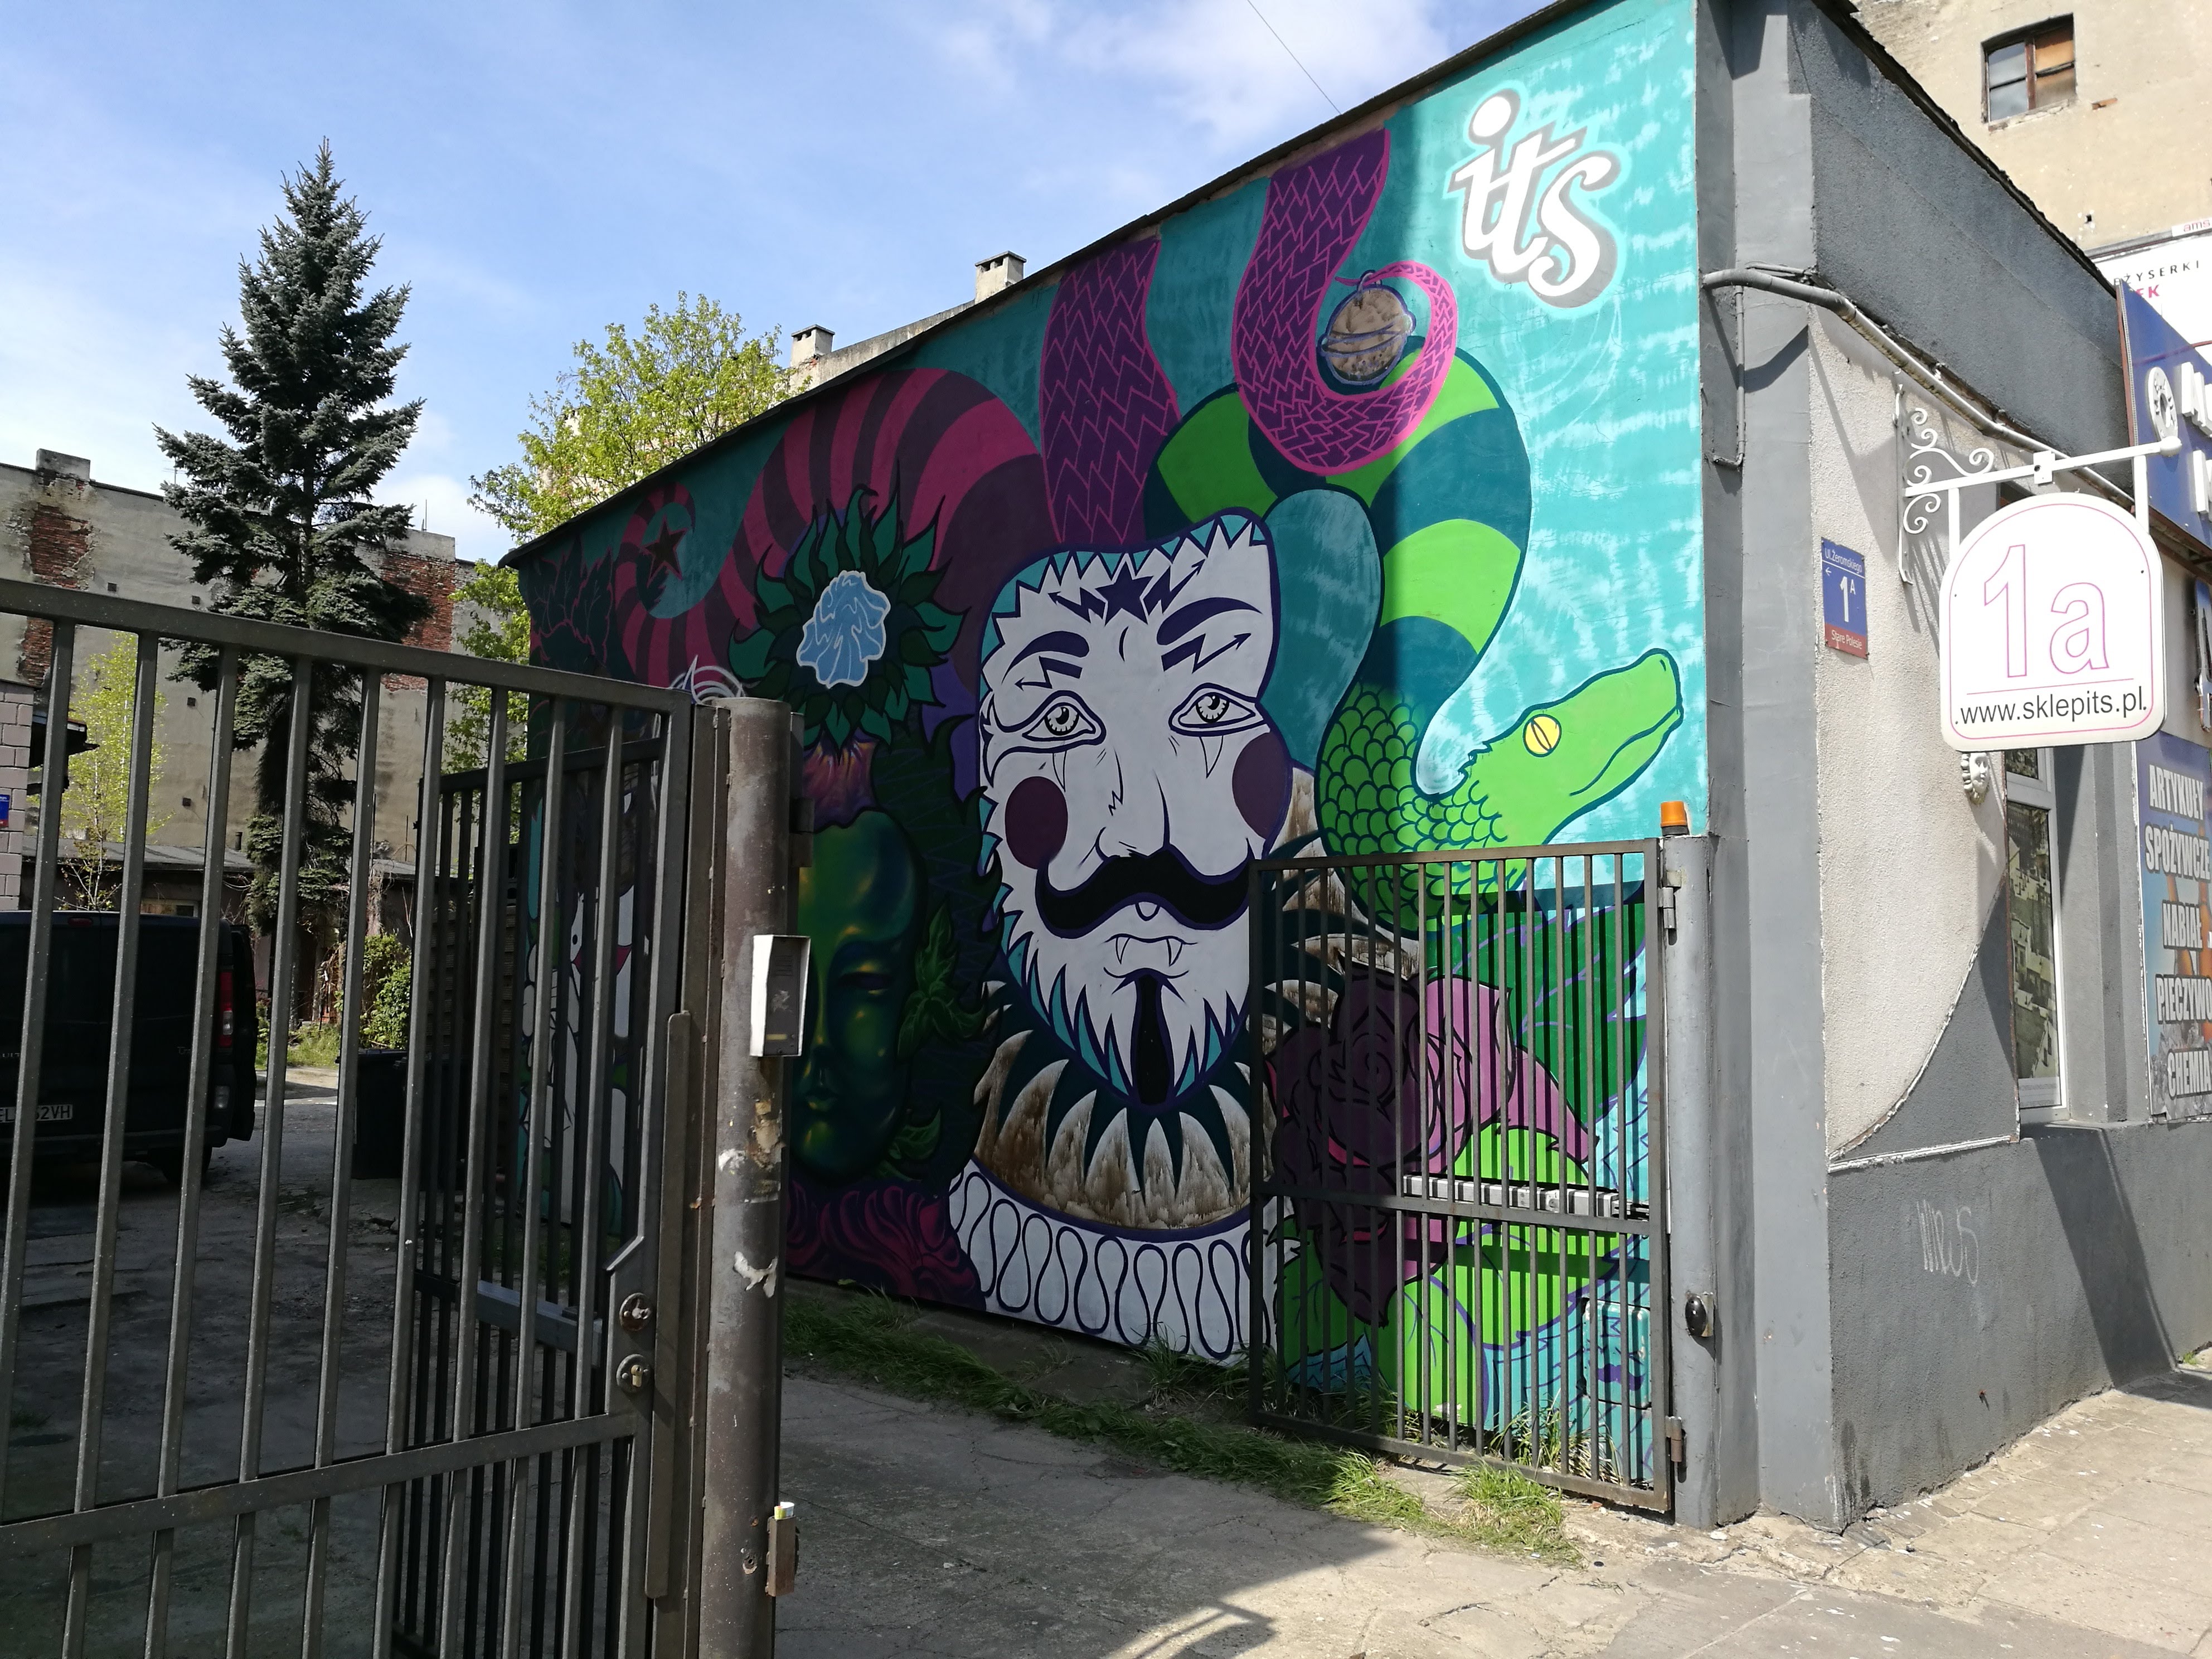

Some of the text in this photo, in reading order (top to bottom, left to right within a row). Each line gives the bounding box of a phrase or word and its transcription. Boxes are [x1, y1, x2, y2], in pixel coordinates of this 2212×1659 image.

[1451, 91, 1616, 302] its
[2183, 220, 2210, 232] ams
[1983, 544, 2109, 678] 1a
[1831, 629, 1862, 649] Stare Polesie
[1960, 685, 2142, 724] www.sklepits.pl
[2149, 764, 2204, 821] ARTYKUŁY
[2145, 823, 2211, 880] SPOŻYWCZE
[2162, 902, 2203, 949] NABIAŁ
[2156, 976, 2212, 1022] PIECZYWO
[2167, 1049, 2212, 1098] CHEMIA
